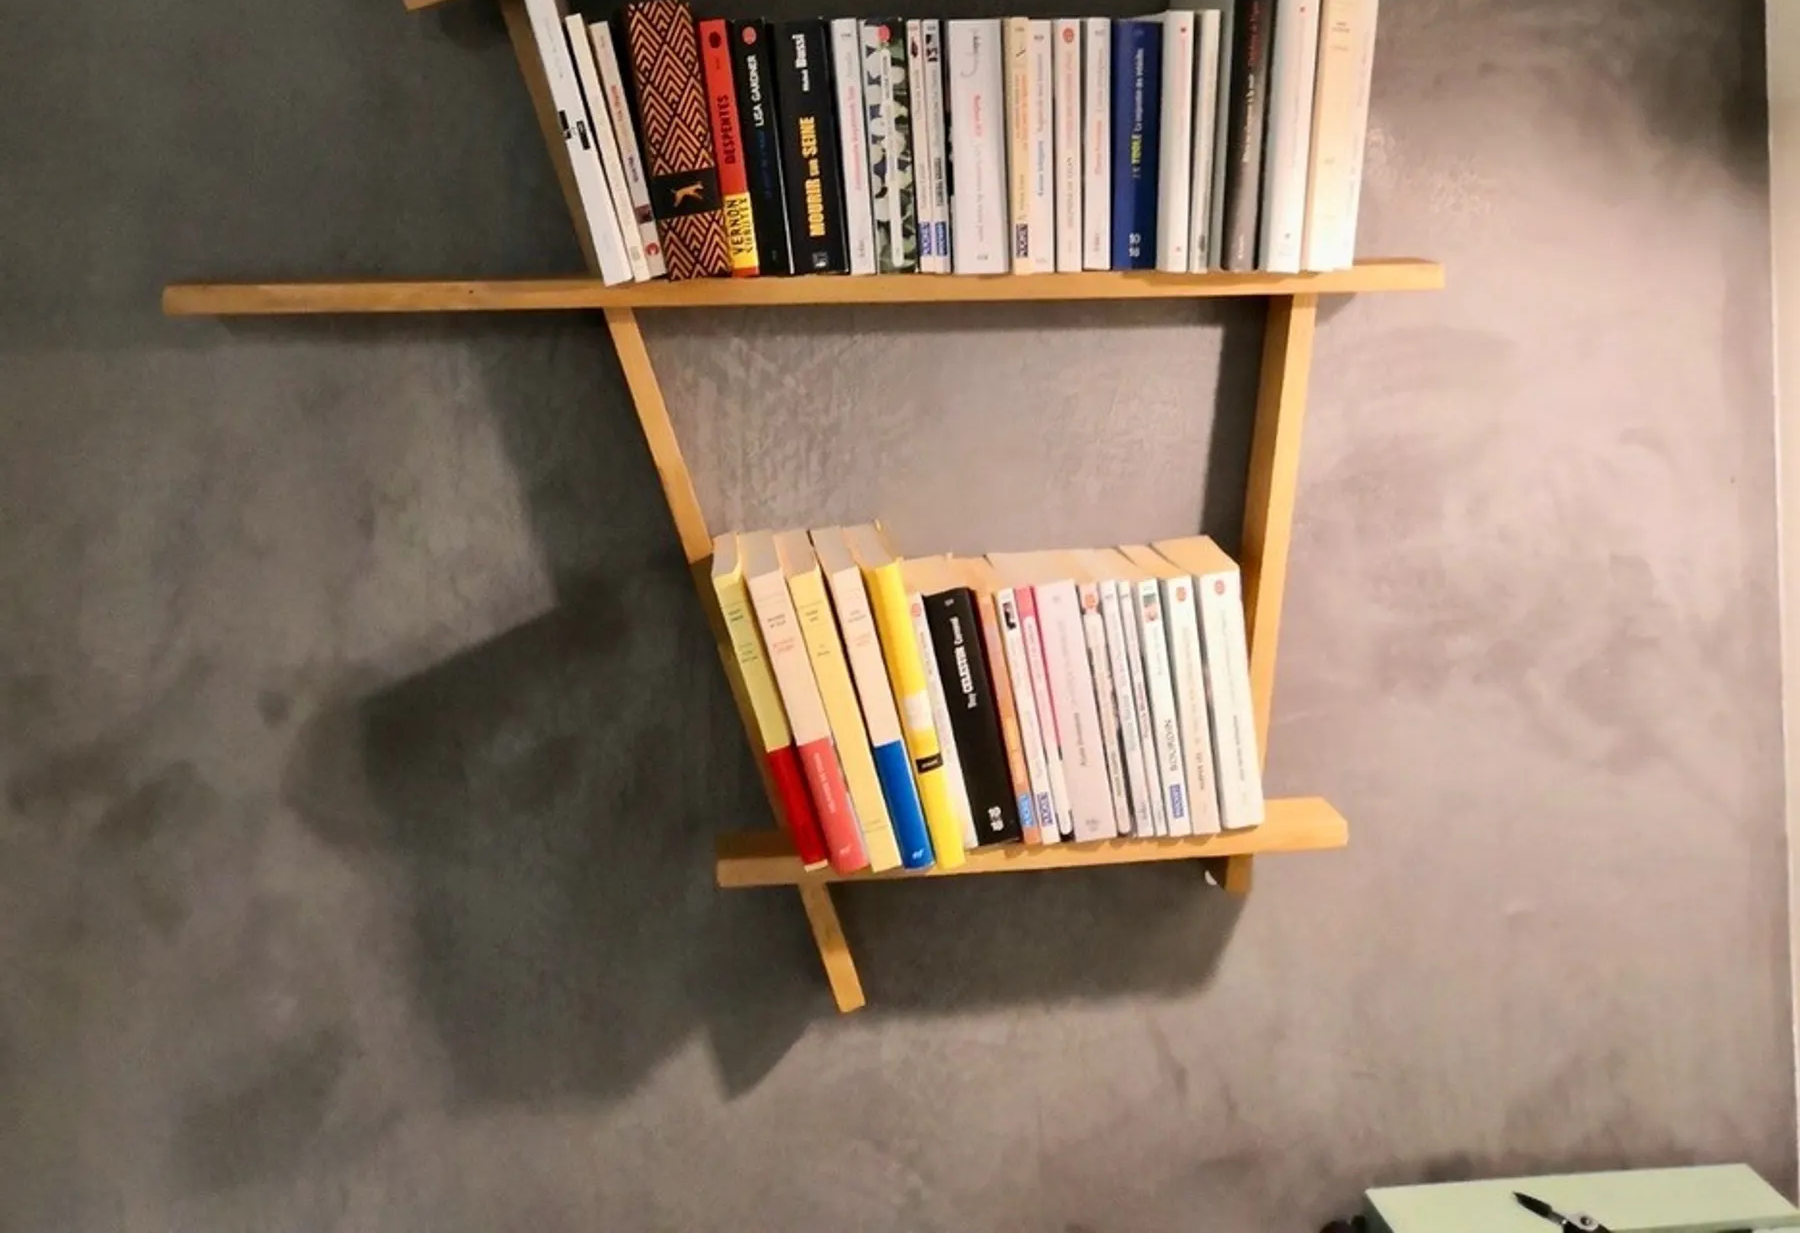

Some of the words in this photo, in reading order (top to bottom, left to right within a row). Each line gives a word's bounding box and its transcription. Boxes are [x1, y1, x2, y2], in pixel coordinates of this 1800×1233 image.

[746, 54, 761, 101] GARDNER
[716, 93, 737, 164] DESPENTES
[752, 103, 764, 126] LISA
[798, 116, 818, 156] SEINE
[726, 198, 744, 255] VERNON
[804, 177, 826, 236] MOURIR
